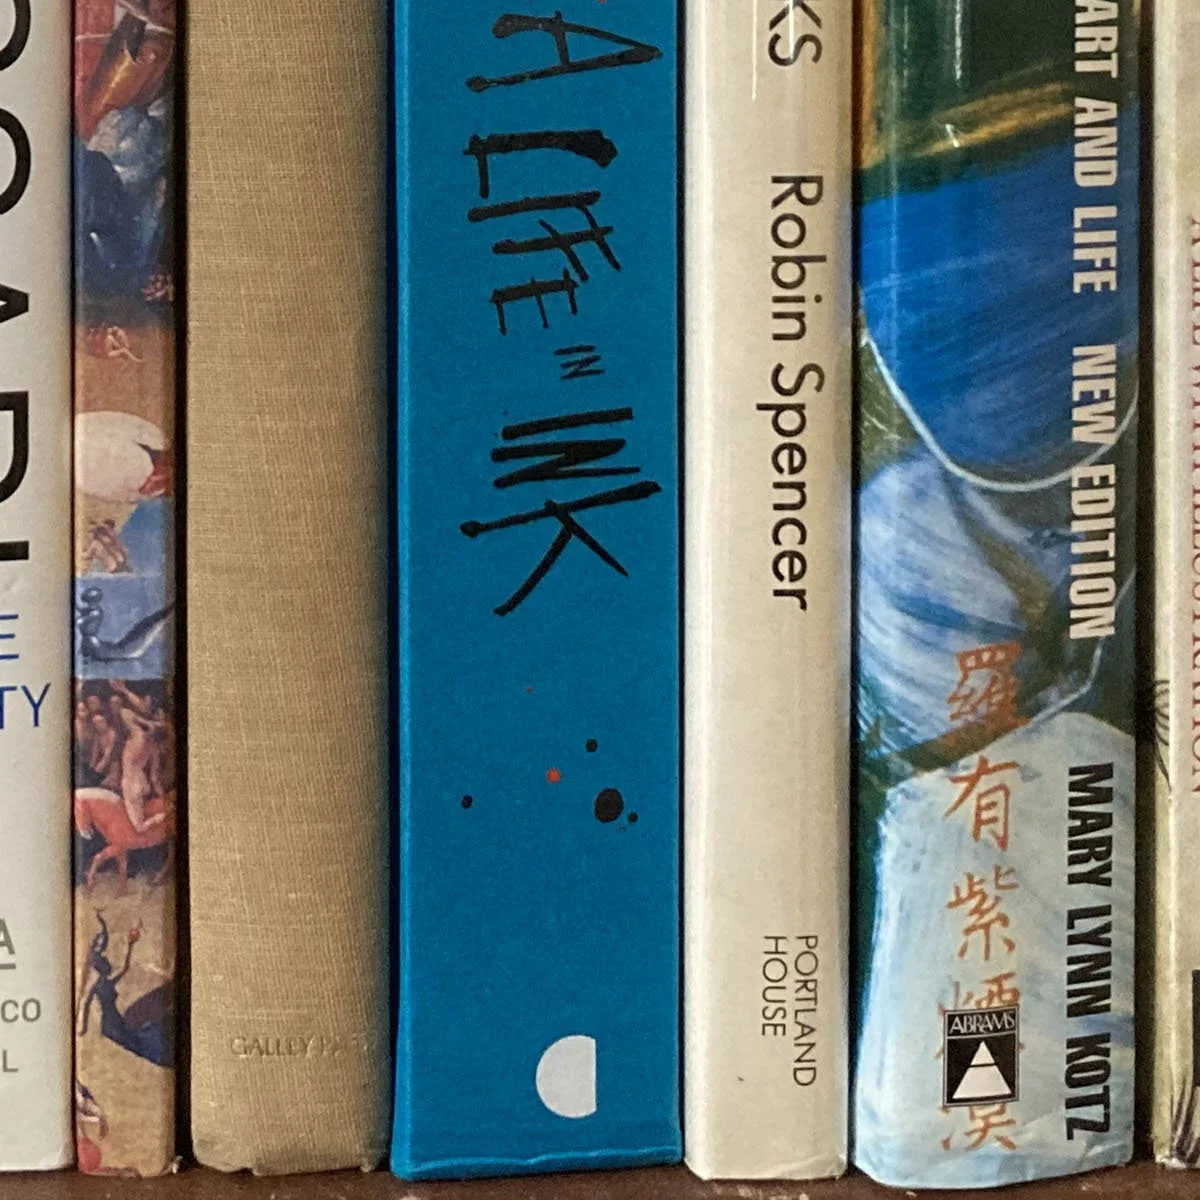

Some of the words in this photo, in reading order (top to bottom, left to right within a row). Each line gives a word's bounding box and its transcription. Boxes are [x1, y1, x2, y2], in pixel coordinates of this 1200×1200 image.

[465, 11, 661, 92] A
[1073, 96, 1118, 187] AND
[463, 130, 620, 335] LIFE
[770, 175, 826, 341] Robin
[1072, 205, 1117, 293] LIFE
[554, 345, 605, 380] IN
[1071, 344, 1117, 443] NEW
[460, 407, 661, 617] INK
[757, 364, 826, 611] Spencer
[1069, 462, 1116, 641] EDITION
[1067, 762, 1114, 888] MARY
[761, 935, 787, 1037] HOUSE
[793, 934, 818, 1087] PORTLAND
[1066, 903, 1113, 1019] LYNN
[948, 1010, 1017, 1033] ABRAMS
[1064, 1037, 1112, 1141] KOTZ
